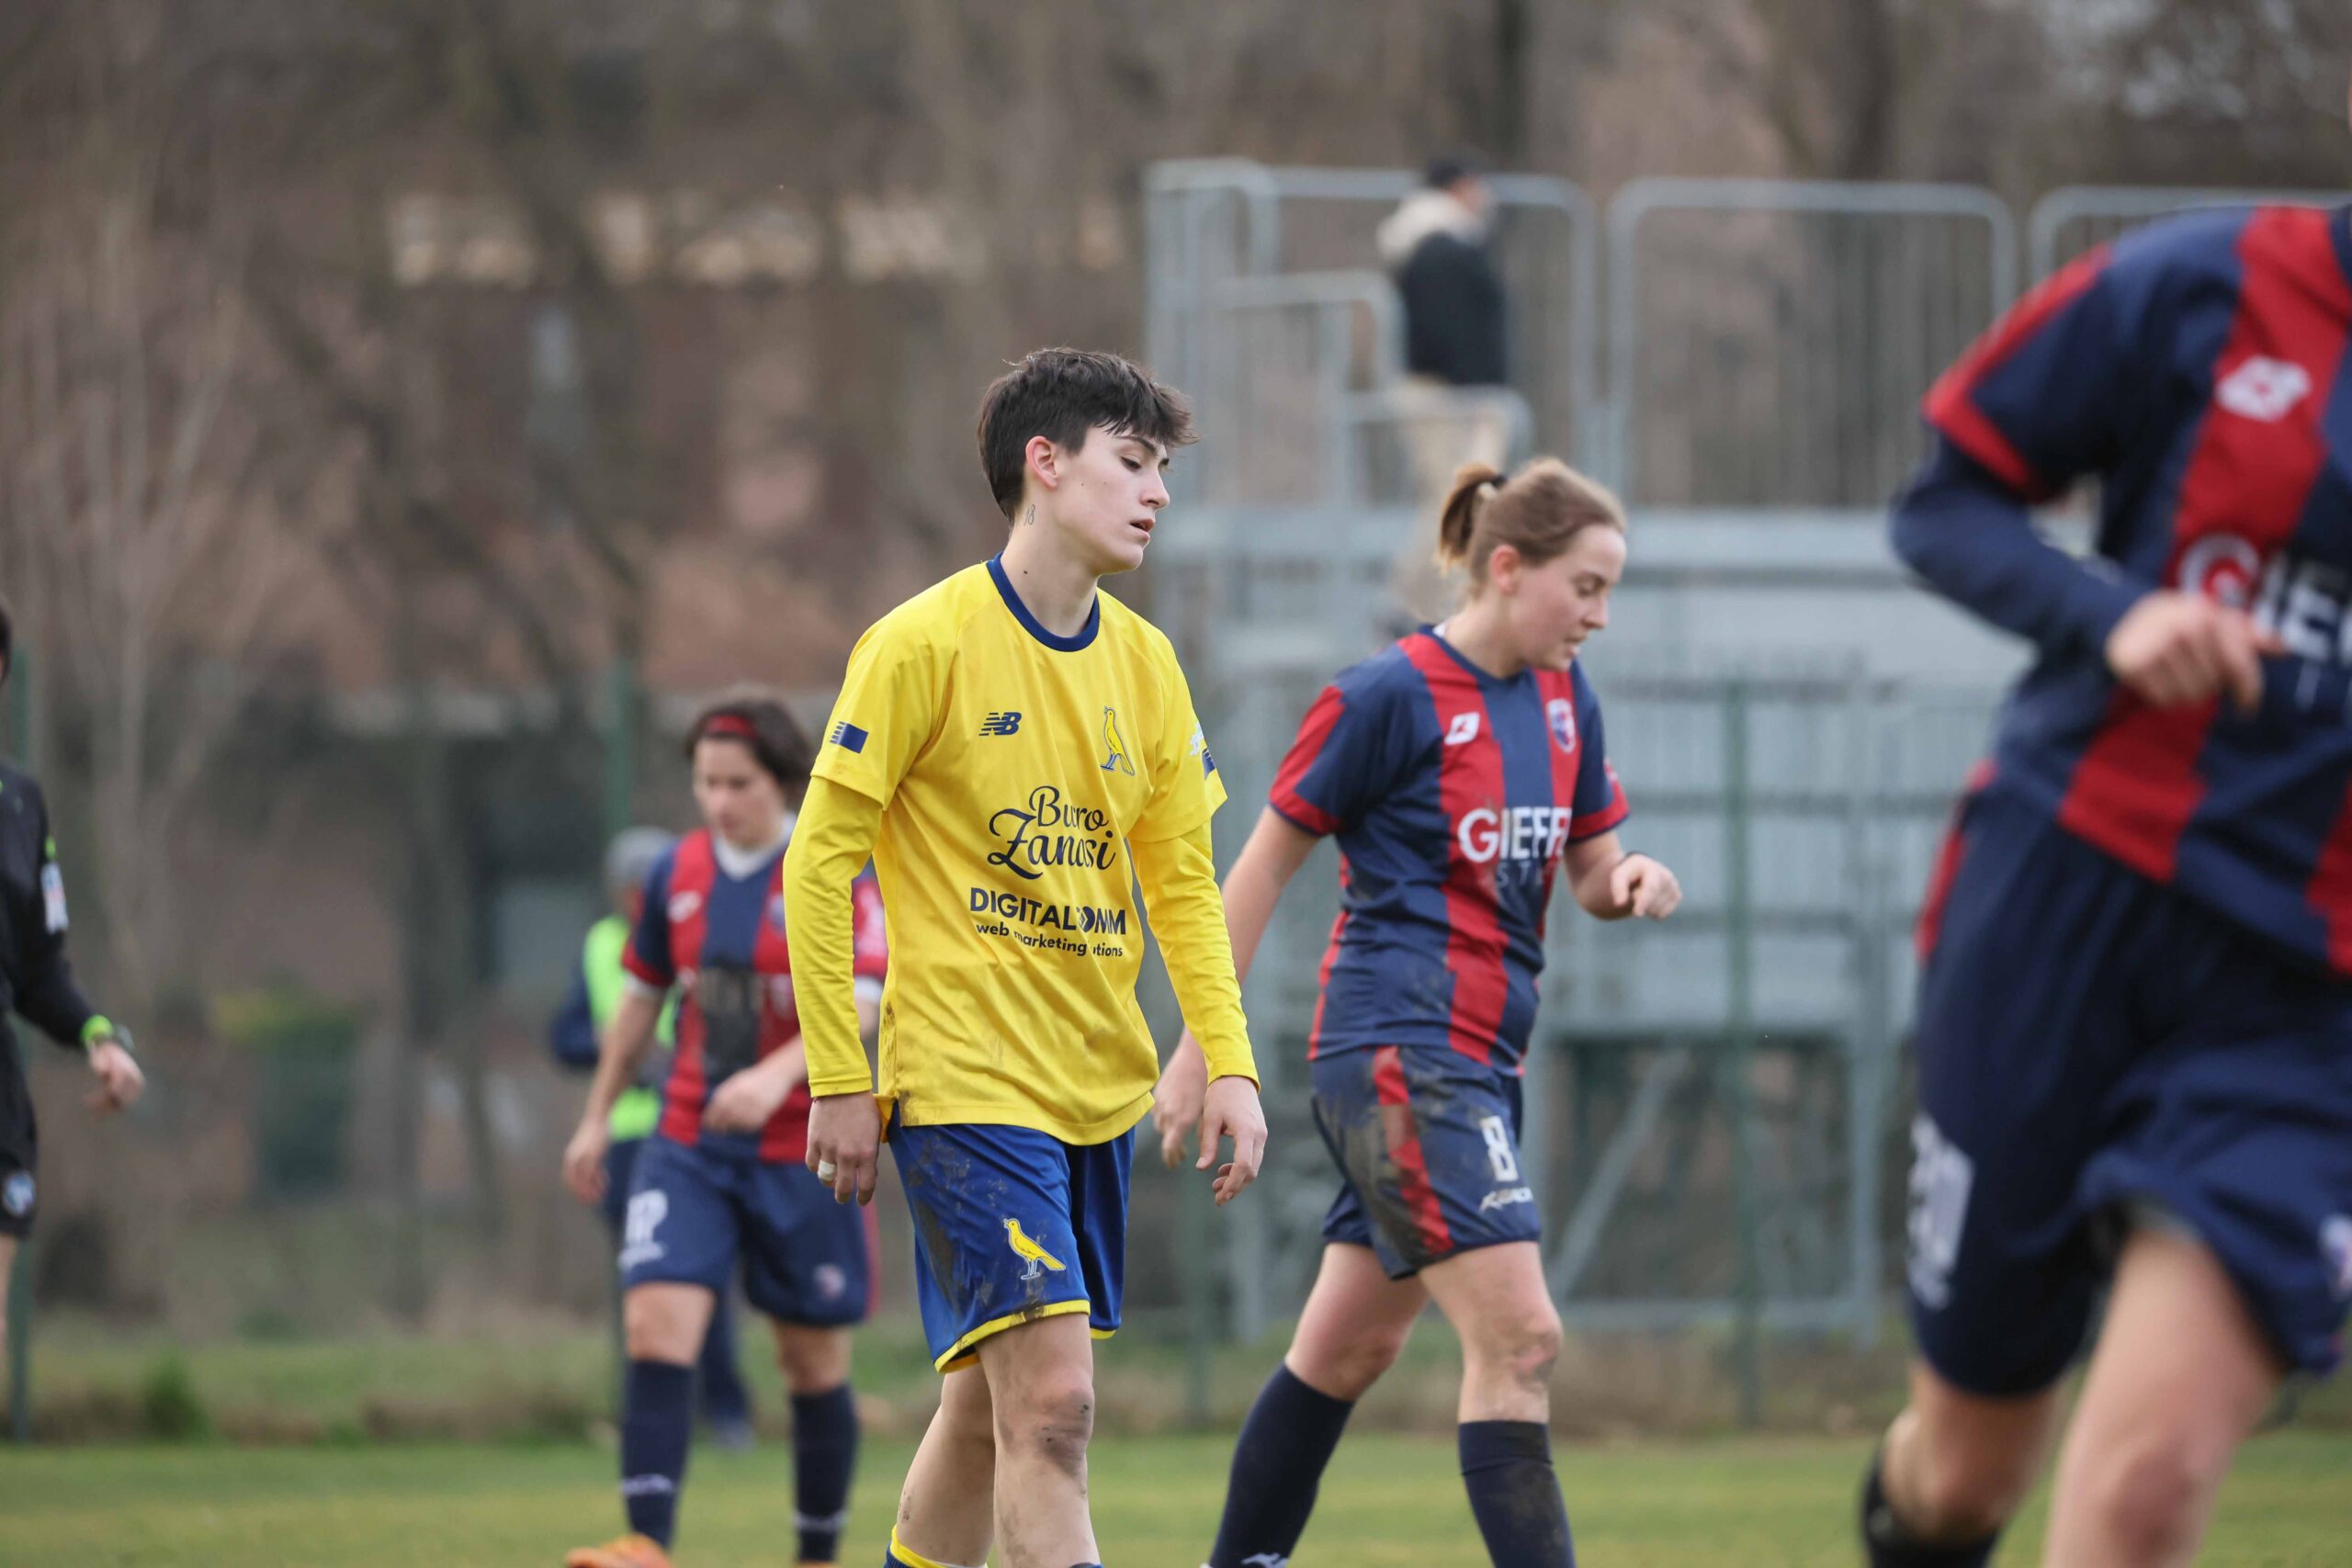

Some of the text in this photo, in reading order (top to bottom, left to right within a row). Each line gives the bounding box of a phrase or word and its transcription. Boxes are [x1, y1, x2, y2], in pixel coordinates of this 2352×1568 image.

[1029, 785, 1109, 831] Buro
[987, 808, 1115, 880] Zanasi
[970, 887, 1126, 935] DIGITALOMM
[977, 921, 1010, 937] web
[1013, 931, 1087, 956] marketing
[1479, 1115, 1519, 1182] 8
